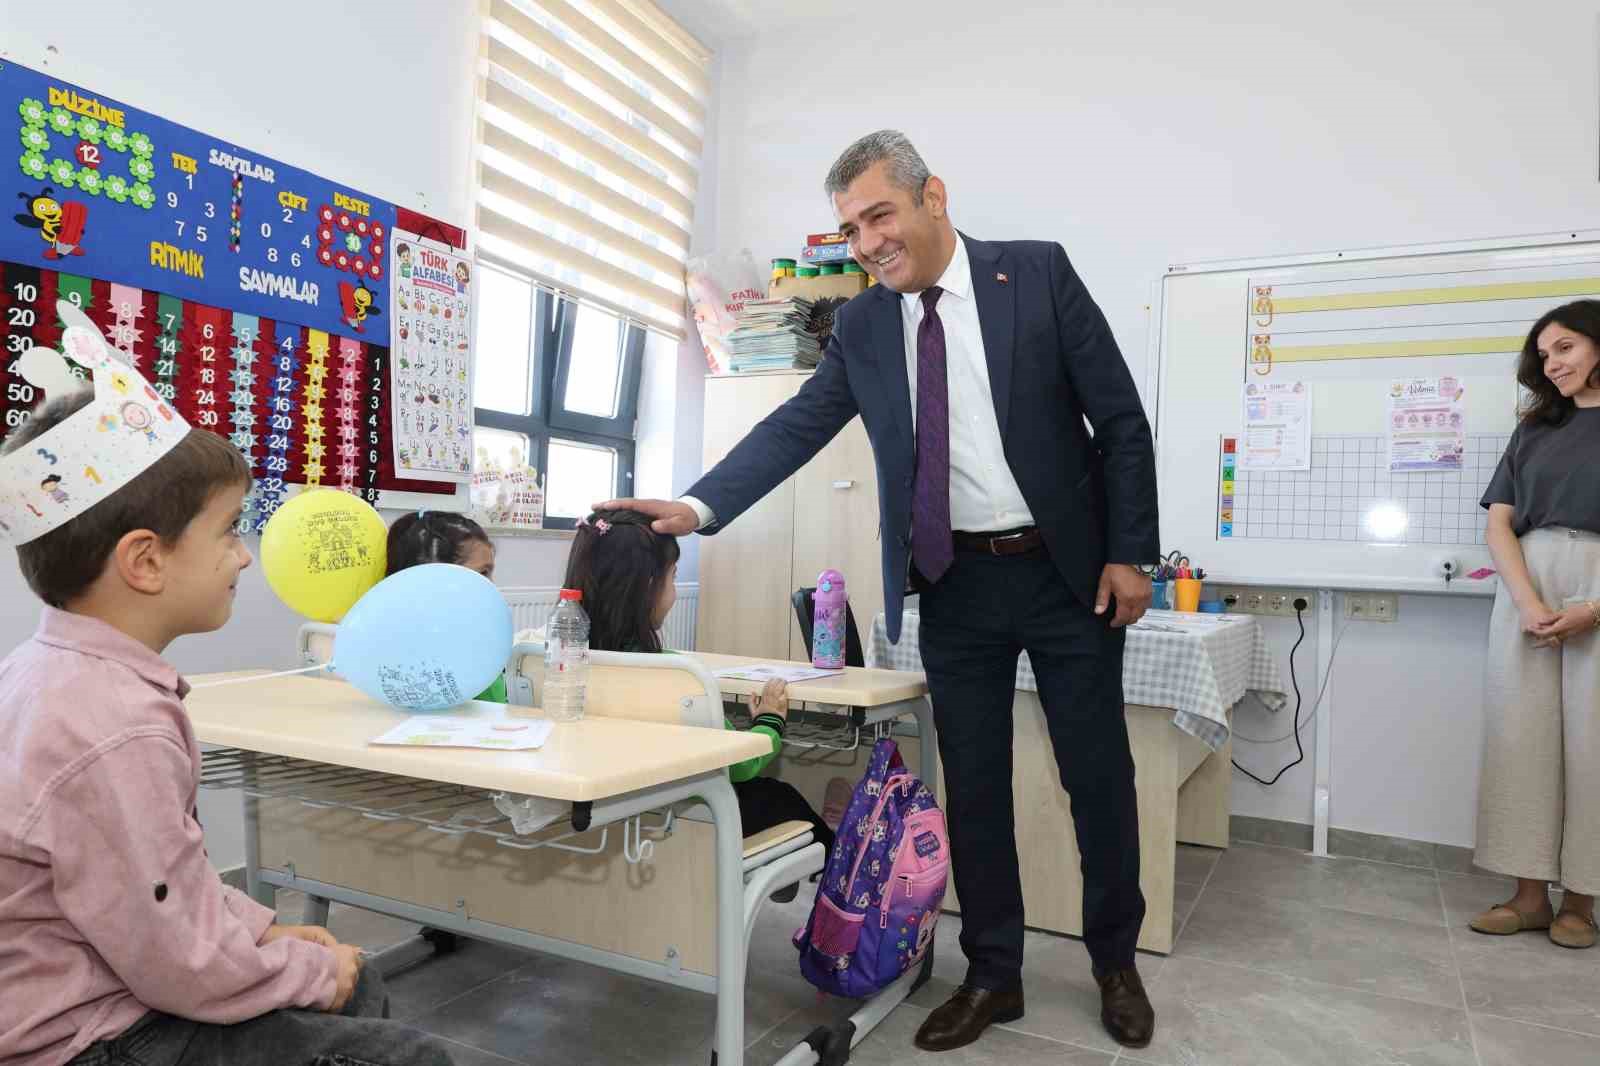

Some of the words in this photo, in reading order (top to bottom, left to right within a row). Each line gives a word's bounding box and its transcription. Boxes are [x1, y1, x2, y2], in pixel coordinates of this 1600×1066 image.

[79, 144, 100, 164] 12
[172, 153, 198, 174] TEK
[185, 174, 194, 190] 1
[167, 192, 178, 208] 9
[333, 191, 370, 217] DESTE
[204, 202, 215, 219] 3
[282, 208, 294, 224] 2
[175, 220, 186, 237] 7
[196, 226, 208, 242] 5
[260, 222, 272, 238] 0
[301, 234, 312, 249] 4
[266, 247, 279, 262] 8
[290, 252, 301, 268] 6
[420, 250, 449, 272] TÜRK
[14, 282, 38, 303] 10
[239, 266, 320, 306] SAYMALAR
[68, 291, 82, 308] 9
[8, 308, 36, 327] 20
[120, 302, 133, 319] 8
[165, 314, 176, 330] 7
[203, 323, 214, 340] 6
[240, 327, 250, 341] 5
[7, 335, 34, 353] 30
[160, 337, 176, 355] 14
[282, 336, 294, 351] 4
[200, 345, 216, 362] 12
[238, 349, 253, 364] 10
[345, 348, 355, 362] 2
[158, 360, 175, 376] 21
[280, 356, 291, 371] 8
[374, 358, 382, 372] 1
[200, 368, 215, 384] 18
[236, 371, 251, 386] 15
[372, 377, 382, 391] 2
[276, 377, 293, 392] 12
[8, 383, 35, 403] 50
[195, 390, 216, 406] 24
[236, 391, 253, 406] 20
[343, 388, 353, 401] 6
[274, 396, 291, 412] 16
[370, 396, 380, 410] 3
[197, 411, 218, 426] 30
[343, 407, 353, 420] 8
[368, 414, 378, 428] 4
[272, 414, 293, 430] 20
[233, 434, 254, 448] 30
[269, 434, 289, 450] 24
[370, 431, 379, 445] 5
[267, 455, 288, 472] 28
[369, 449, 378, 464] 6
[368, 469, 377, 483] 7
[263, 477, 283, 493] 32
[367, 488, 376, 502] 8
[259, 498, 280, 514] 36
